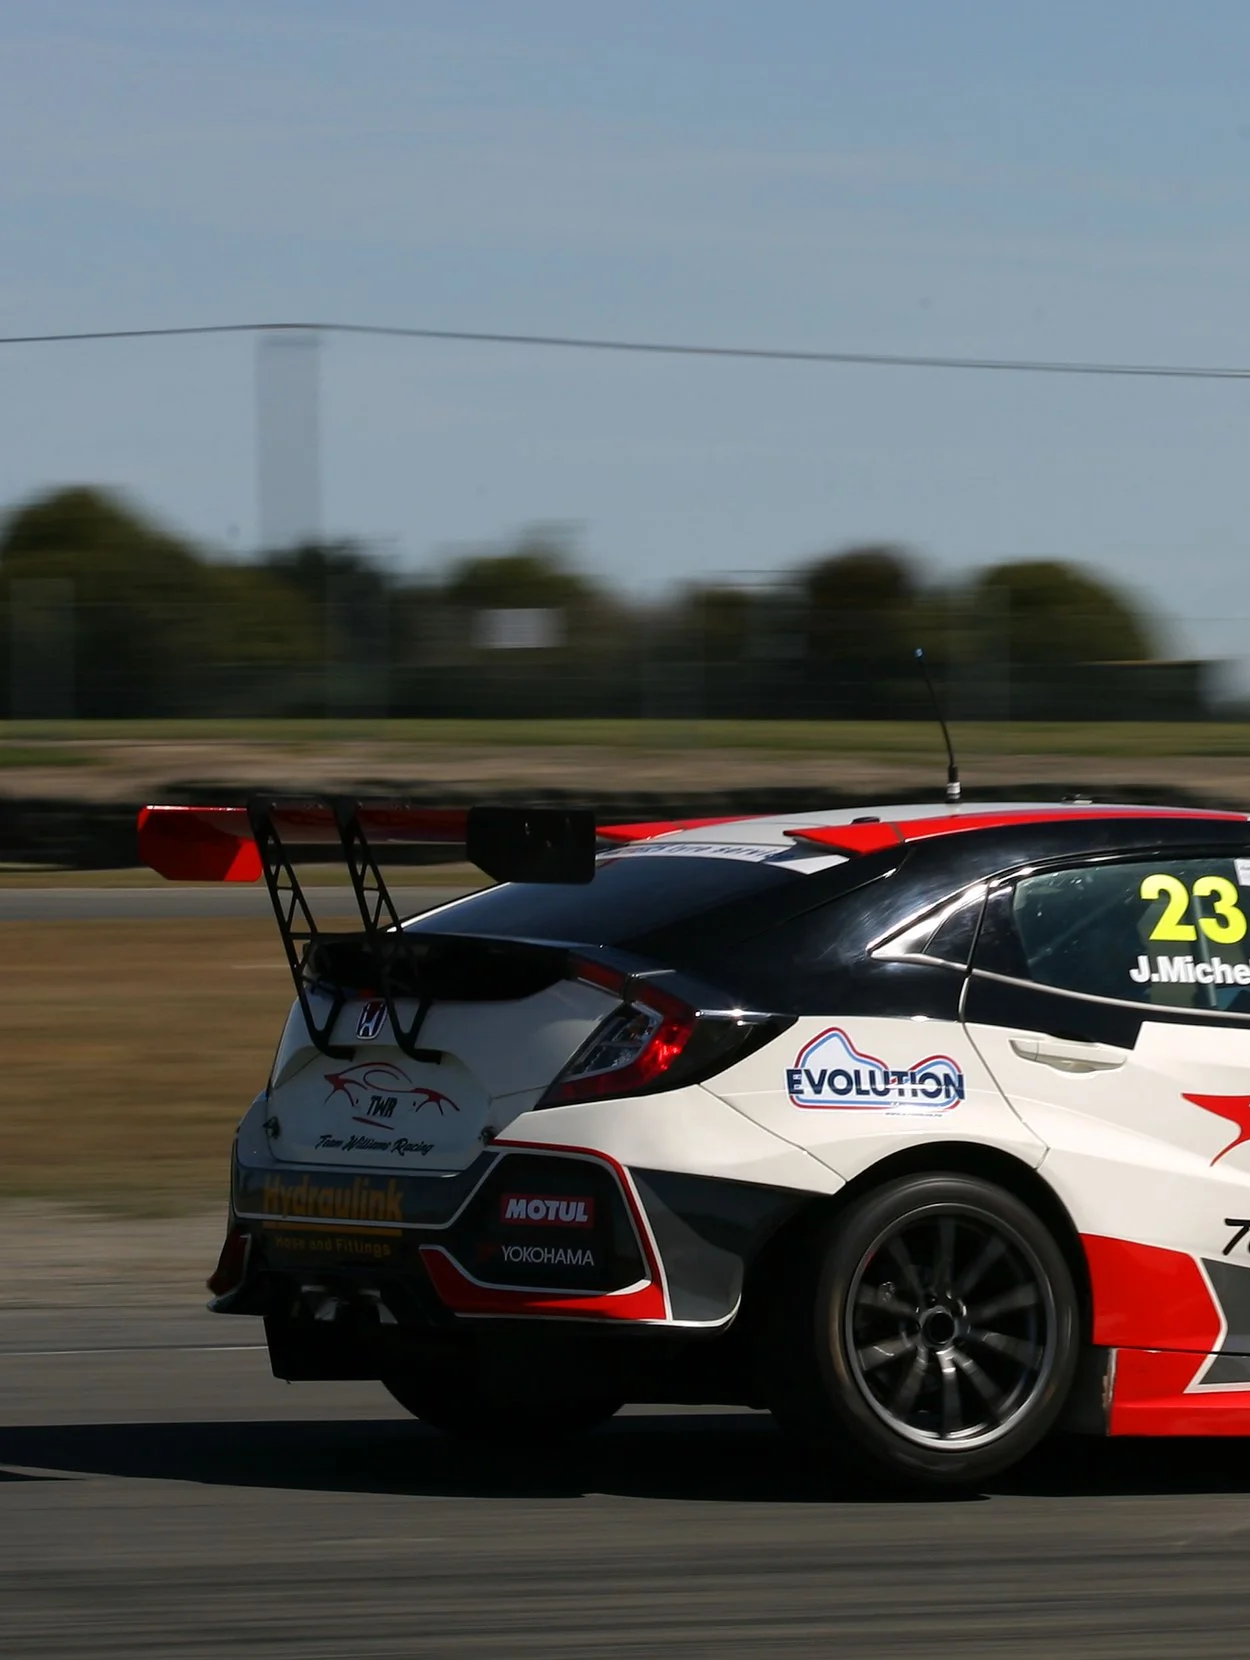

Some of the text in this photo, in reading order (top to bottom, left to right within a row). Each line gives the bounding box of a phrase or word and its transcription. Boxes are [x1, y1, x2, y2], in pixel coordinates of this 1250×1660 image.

[1140, 873, 1248, 944] 23
[786, 1068, 965, 1100] EVOLUTION
[366, 1095, 398, 1118] TWR
[391, 1138, 435, 1156] Racing
[263, 1173, 404, 1220] Hydraulink
[505, 1198, 588, 1222] MOTUL
[309, 1236, 333, 1251] and
[335, 1238, 392, 1259] Fittings
[502, 1245, 595, 1266] YOKOHAMA
